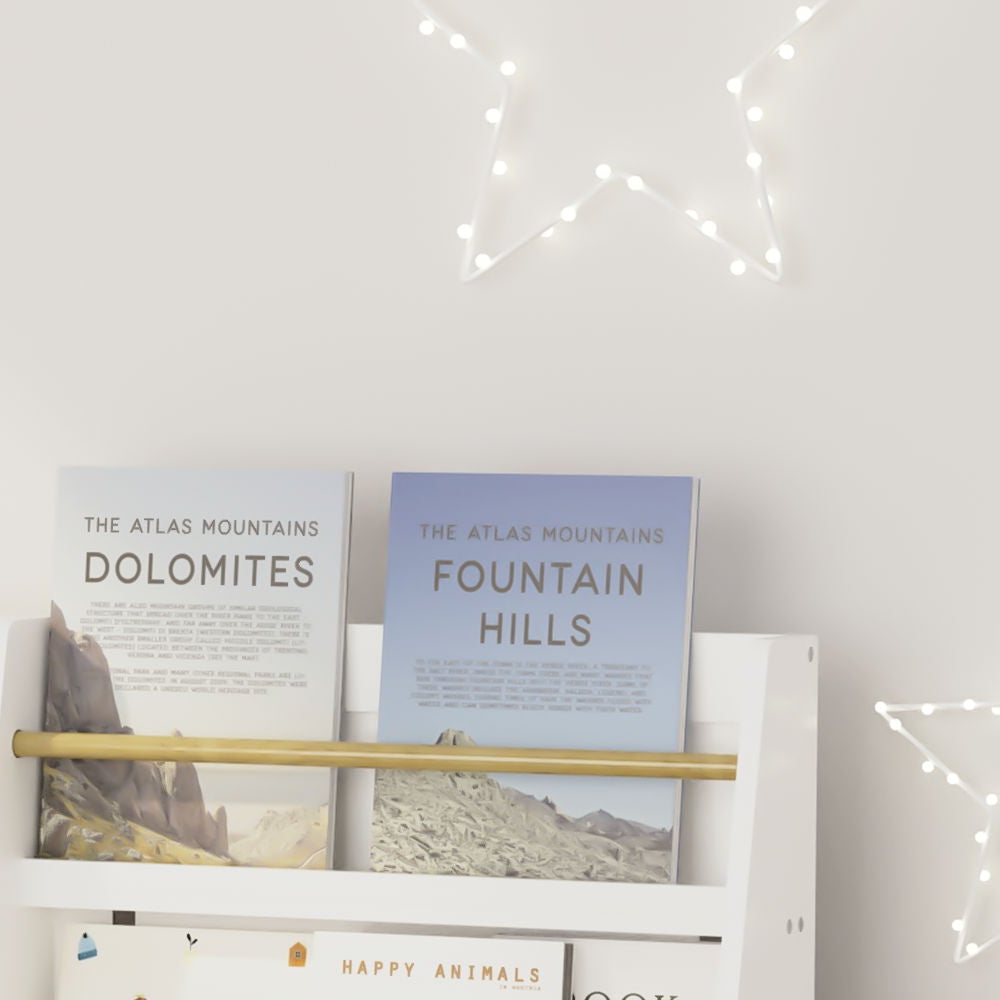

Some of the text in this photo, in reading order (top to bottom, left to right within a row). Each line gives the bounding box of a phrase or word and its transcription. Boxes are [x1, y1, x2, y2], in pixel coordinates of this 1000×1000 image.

[84, 516, 320, 537] THE ATLAS MOUNTAINS
[418, 523, 665, 545] THE ATLAS MOUNTAINS
[84, 551, 315, 588] DOLOMITES
[433, 559, 644, 596] FOUNTAIN
[479, 611, 592, 647] HILLS
[341, 959, 540, 984] HAPPY ANIMALS
